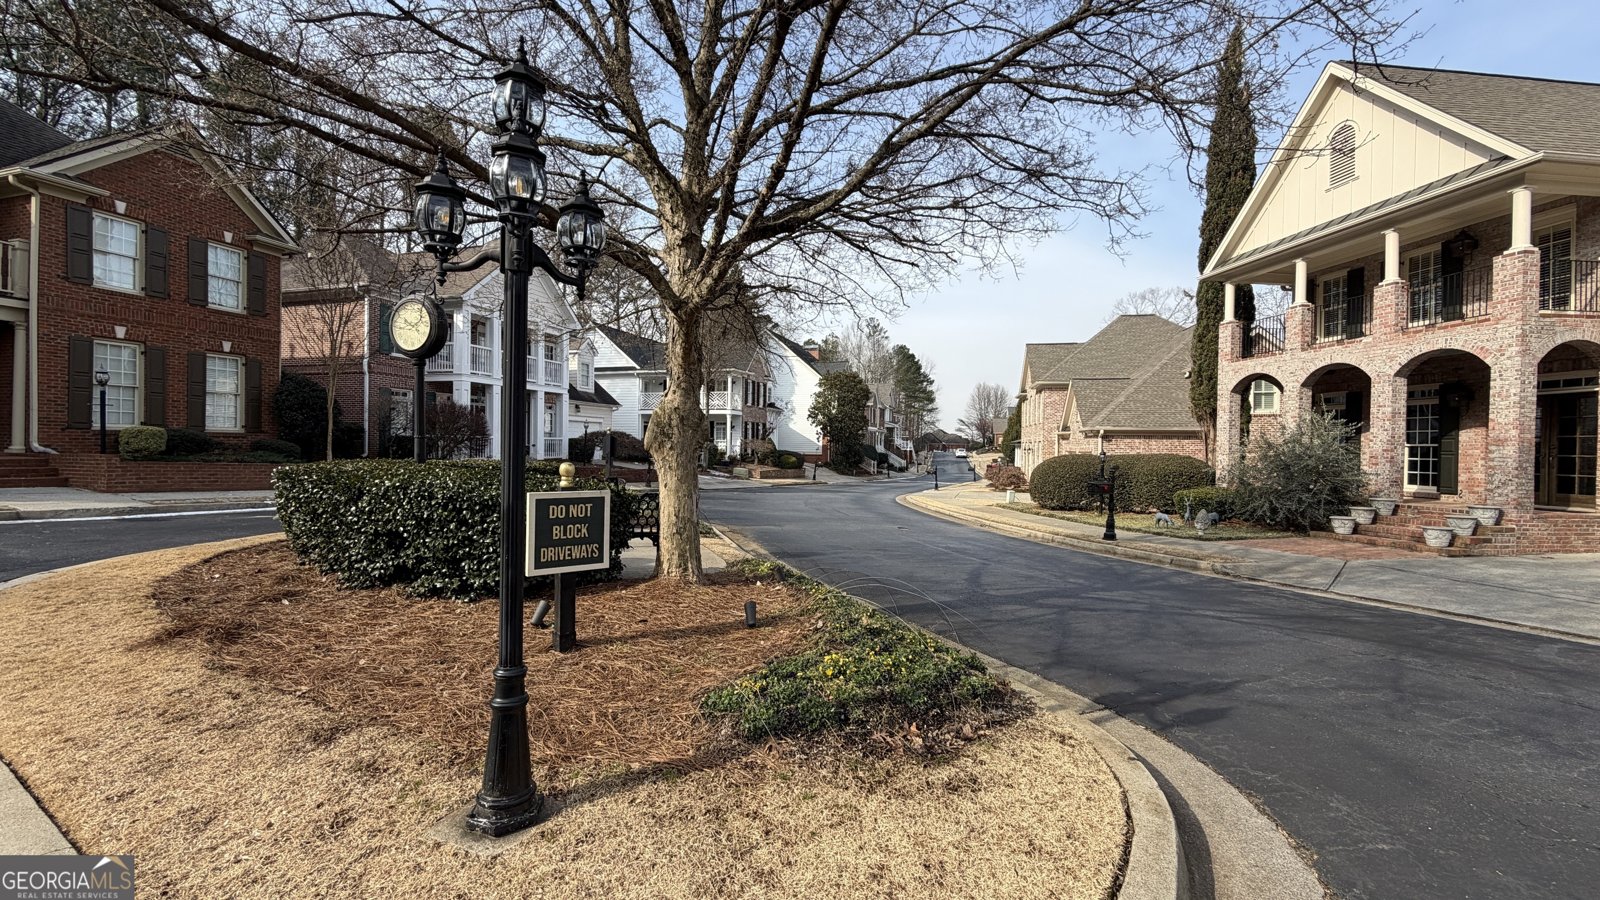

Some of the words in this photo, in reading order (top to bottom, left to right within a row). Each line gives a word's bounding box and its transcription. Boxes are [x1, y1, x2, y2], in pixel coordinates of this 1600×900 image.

[549, 504, 565, 519] DO
[569, 503, 593, 518] NOT
[552, 524, 589, 540] BLOCK
[540, 543, 599, 562] DRIVEWAYS
